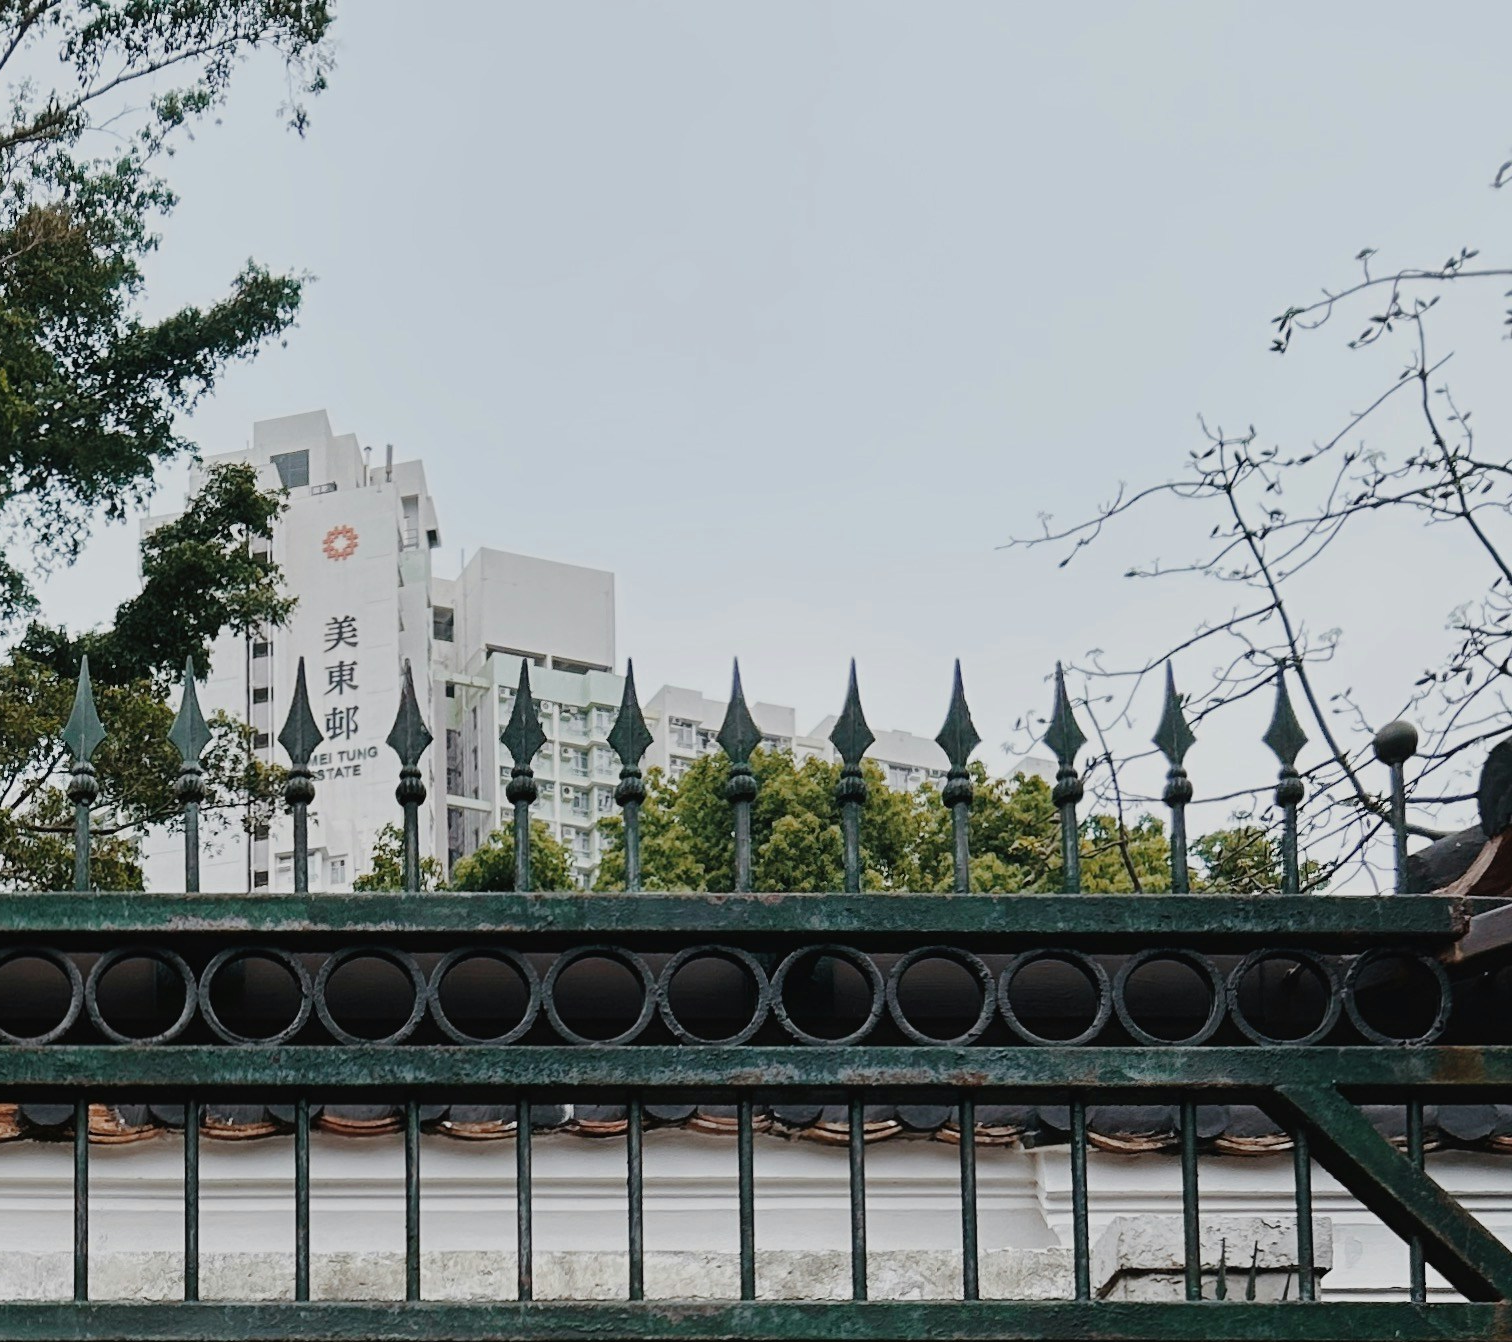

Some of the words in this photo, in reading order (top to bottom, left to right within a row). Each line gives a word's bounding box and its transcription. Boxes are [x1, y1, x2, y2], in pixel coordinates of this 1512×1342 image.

[323, 615, 360, 741] 美東邨
[338, 746, 378, 762] TUNG
